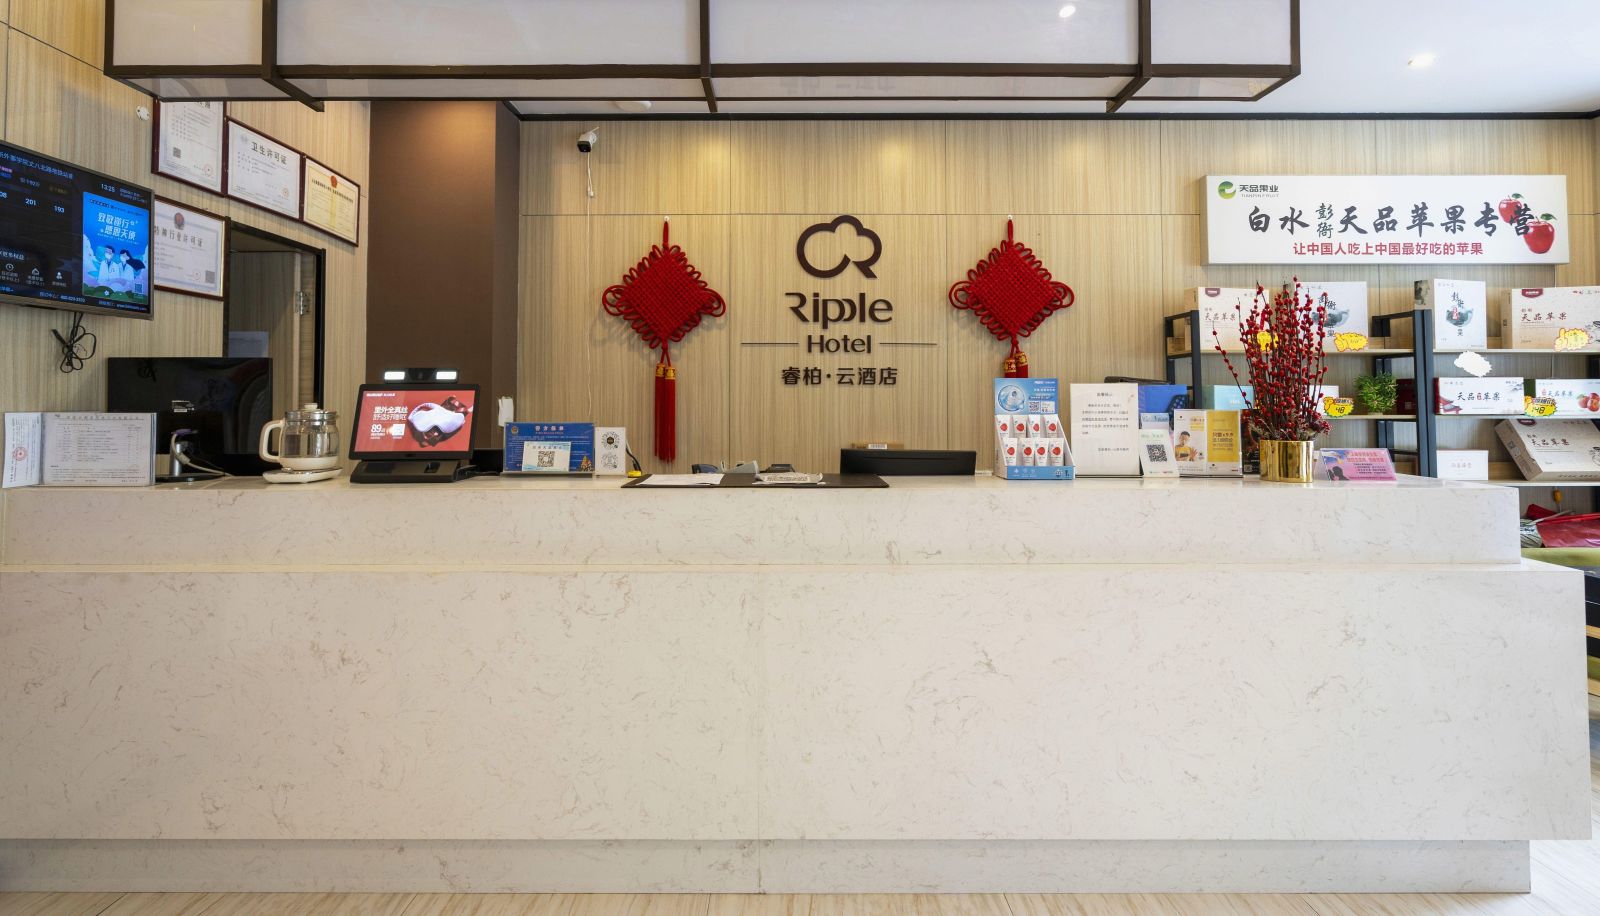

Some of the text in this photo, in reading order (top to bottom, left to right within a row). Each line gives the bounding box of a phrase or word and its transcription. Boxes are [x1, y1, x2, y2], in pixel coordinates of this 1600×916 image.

[251, 141, 287, 166] 卫生许可证
[101, 183, 115, 193] 13:25
[1239, 184, 1279, 193] 天品果业
[25, 198, 36, 206] 201
[1293, 242, 1484, 256] 让中国人吃上中国最好吃的苹果
[785, 292, 893, 330] Ripple
[1521, 312, 1567, 322] 天品苹果
[807, 334, 872, 354] Hotel
[781, 366, 898, 386] 睿柏·云酒店
